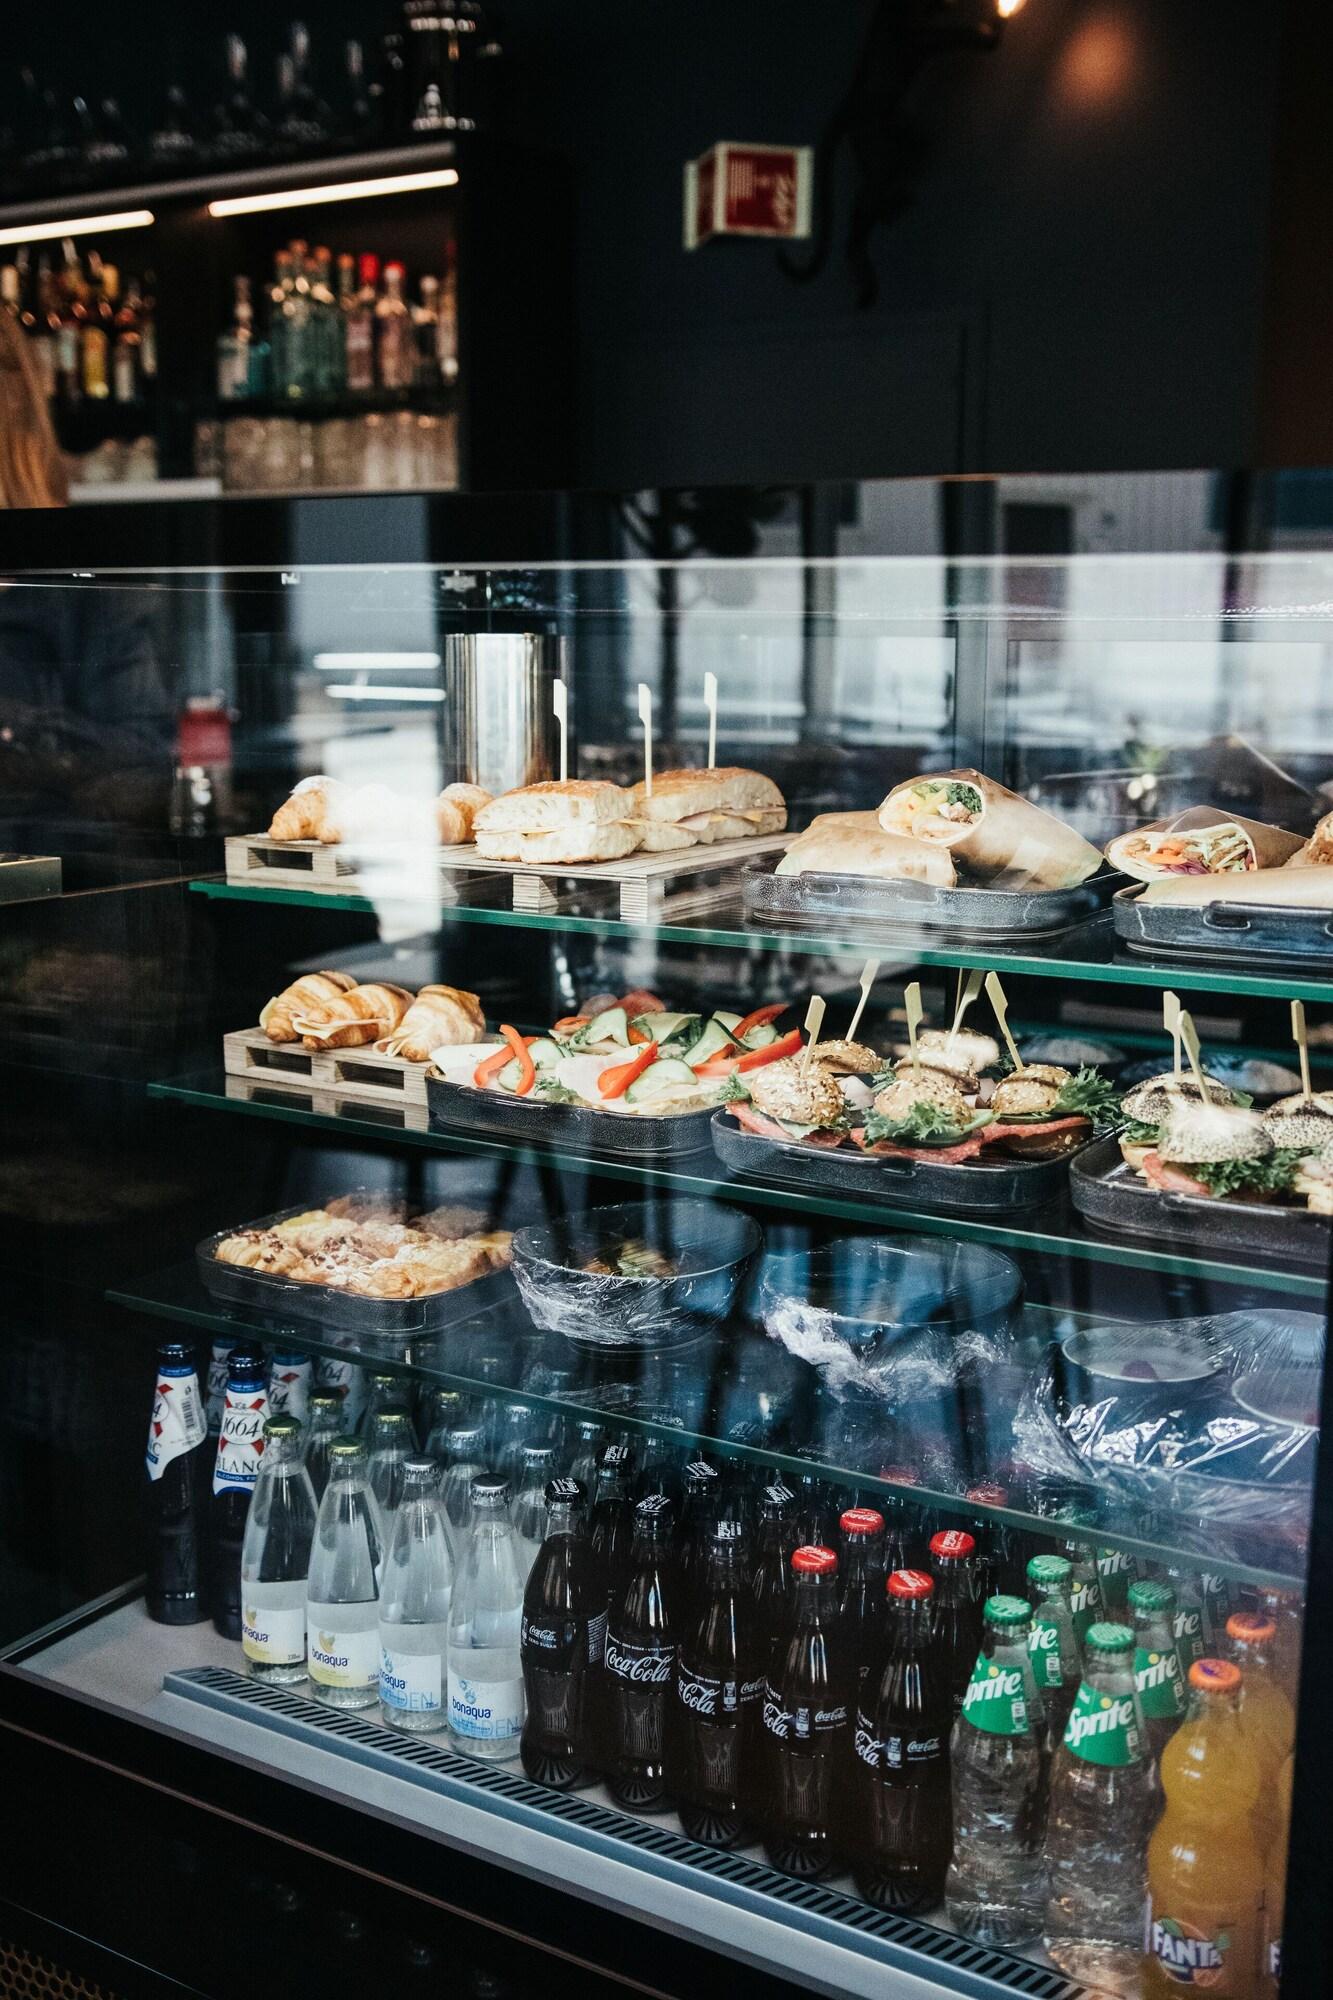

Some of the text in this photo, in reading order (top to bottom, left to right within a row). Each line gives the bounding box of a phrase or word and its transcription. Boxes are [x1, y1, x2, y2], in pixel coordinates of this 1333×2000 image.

[222, 1416, 261, 1438] 1664
[312, 1645, 349, 1668] bonaqua
[1134, 1654, 1179, 1694] rite
[452, 1695, 492, 1720] bonaqua
[1063, 1699, 1134, 1747] Sprite
[1152, 1919, 1224, 1969] FANTA
